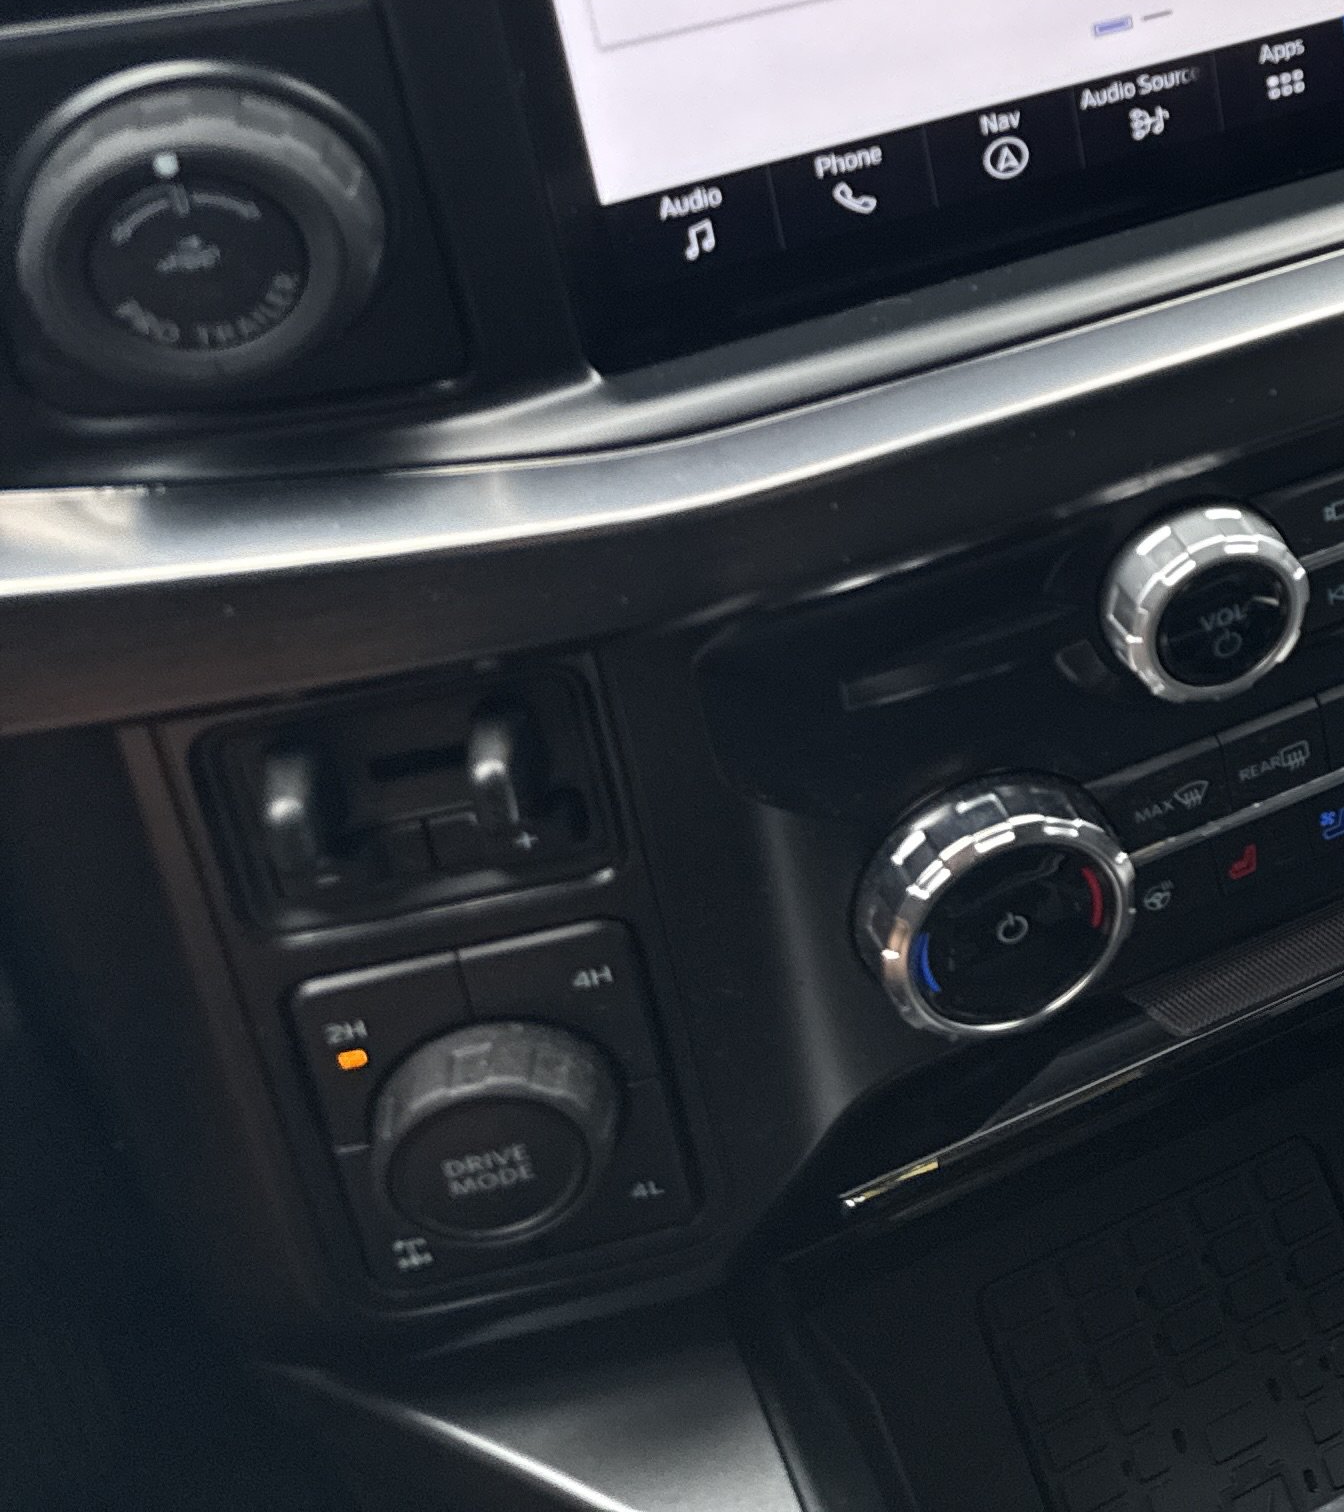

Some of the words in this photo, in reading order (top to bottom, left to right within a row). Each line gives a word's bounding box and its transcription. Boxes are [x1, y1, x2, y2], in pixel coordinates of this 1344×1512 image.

[1258, 38, 1305, 65] Apps
[1080, 80, 1136, 111] Audio
[979, 110, 1021, 137] Nav
[813, 145, 883, 180] Phone
[659, 186, 723, 221] Audio
[1200, 604, 1248, 630] VOL
[1239, 757, 1282, 782] REAR
[1135, 799, 1177, 823] MAX
[572, 965, 615, 989] 4H
[325, 1019, 368, 1044] 2H
[440, 1143, 530, 1180] DRIVE
[449, 1164, 534, 1197] MODE
[631, 1180, 665, 1198] 4L
